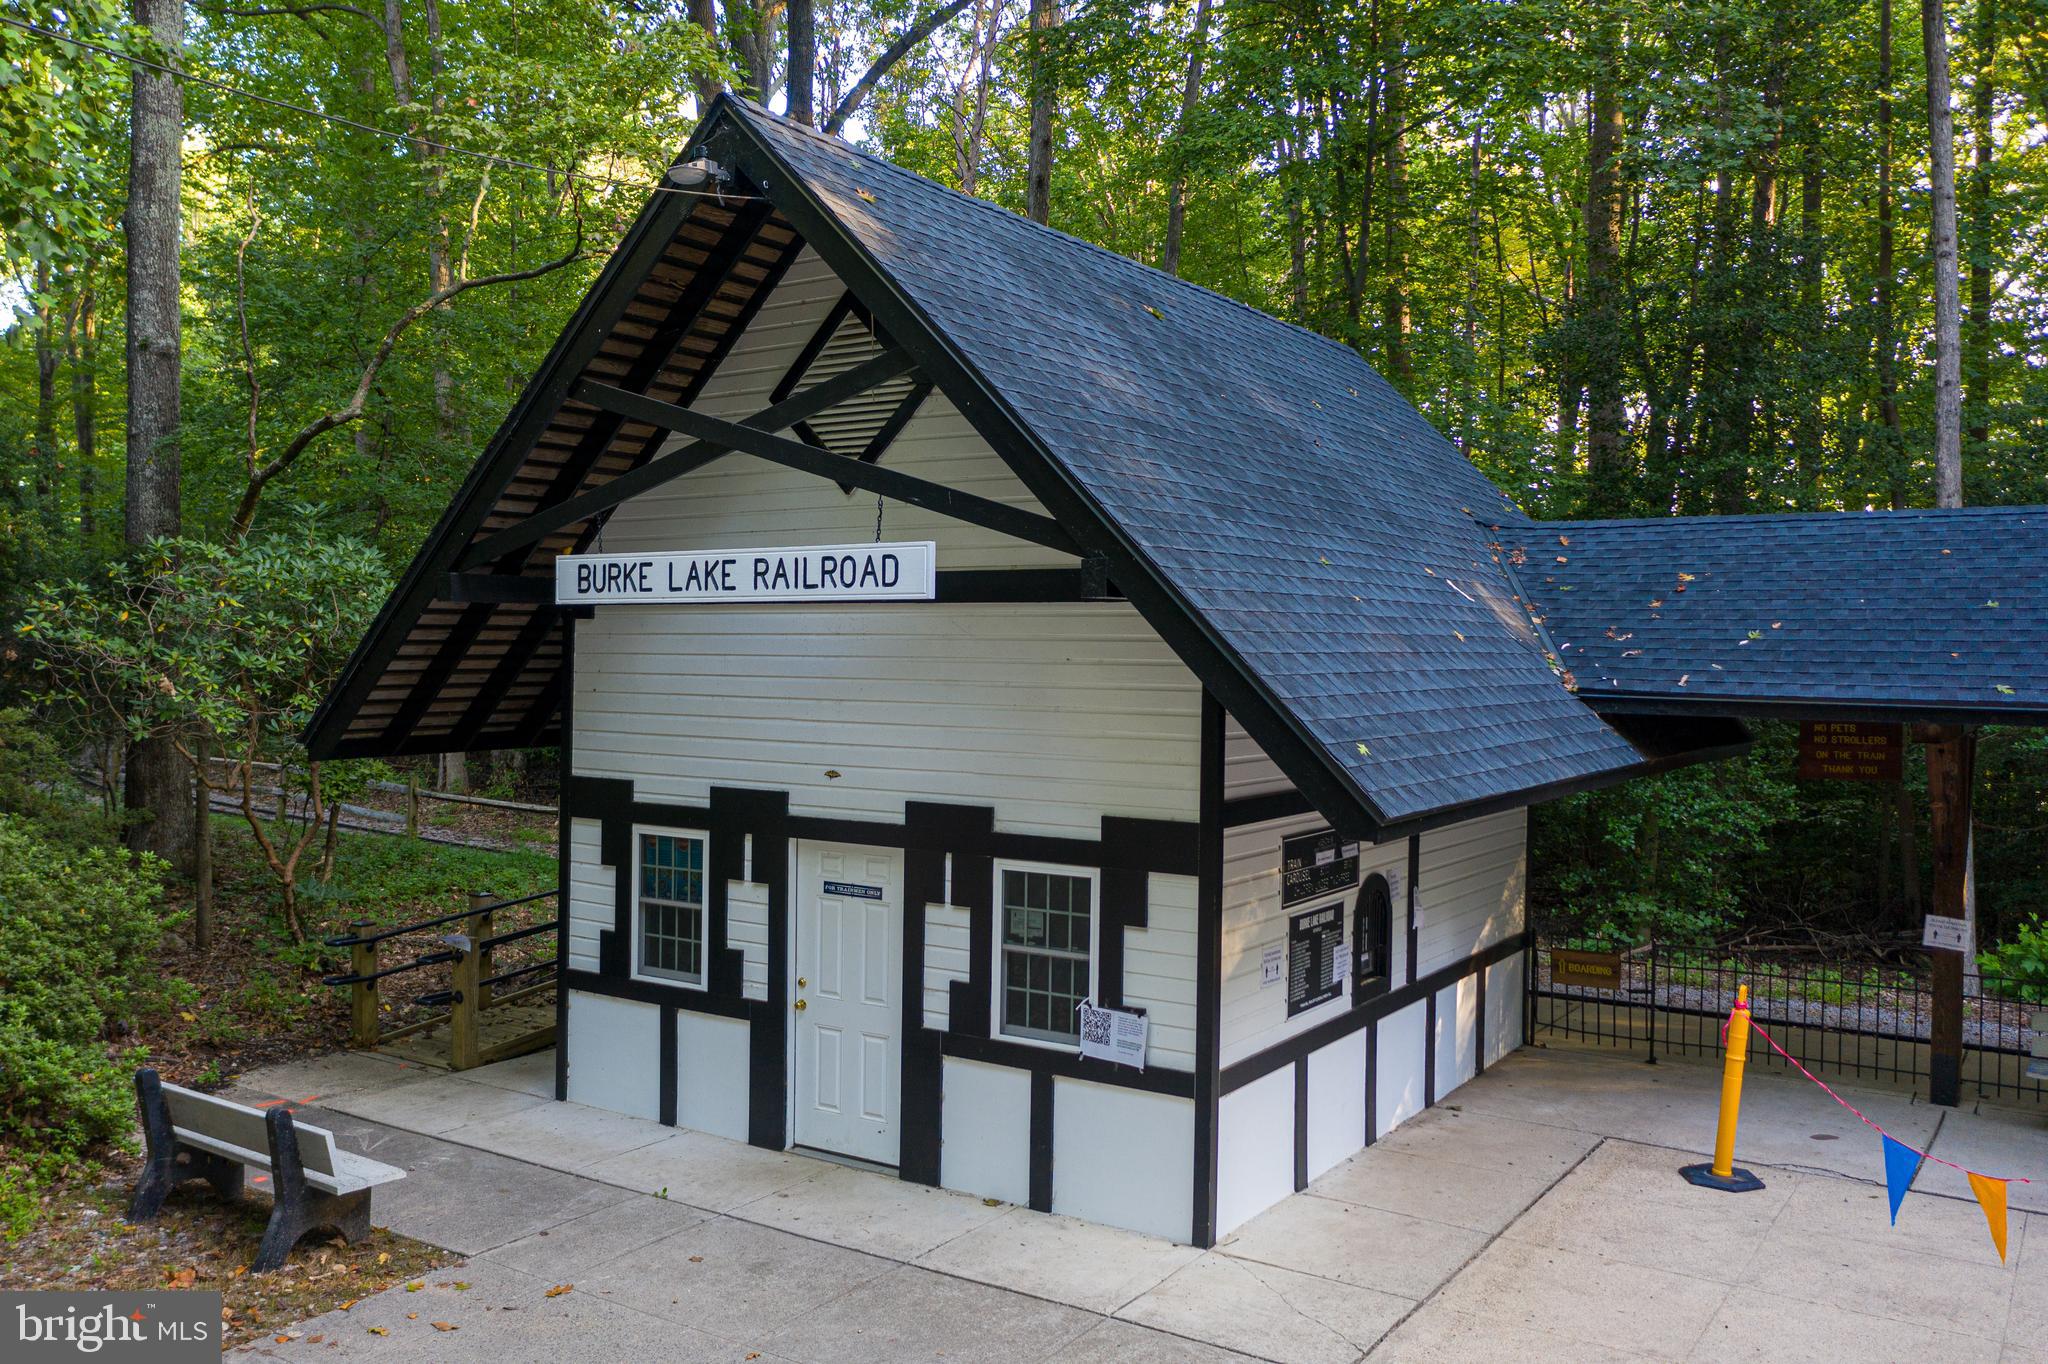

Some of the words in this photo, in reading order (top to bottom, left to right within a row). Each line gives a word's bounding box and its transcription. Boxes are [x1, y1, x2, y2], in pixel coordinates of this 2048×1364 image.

[577, 561, 653, 594] BURKE
[668, 559, 736, 592] LAKE
[753, 553, 899, 590] RAILROAD
[1814, 724, 1827, 732] NO
[1831, 724, 1856, 733] PETS
[1814, 735, 1827, 744] NO
[1831, 736, 1887, 745] STROLLERS
[1816, 751, 1829, 759] ON
[1834, 751, 1852, 760] THE
[1857, 752, 1886, 760] TRAIN
[1823, 764, 1854, 774] THANK
[1859, 766, 1878, 774] YOU
[1287, 858, 1302, 871] TRAIN
[1568, 963, 1612, 976] BOARDING
